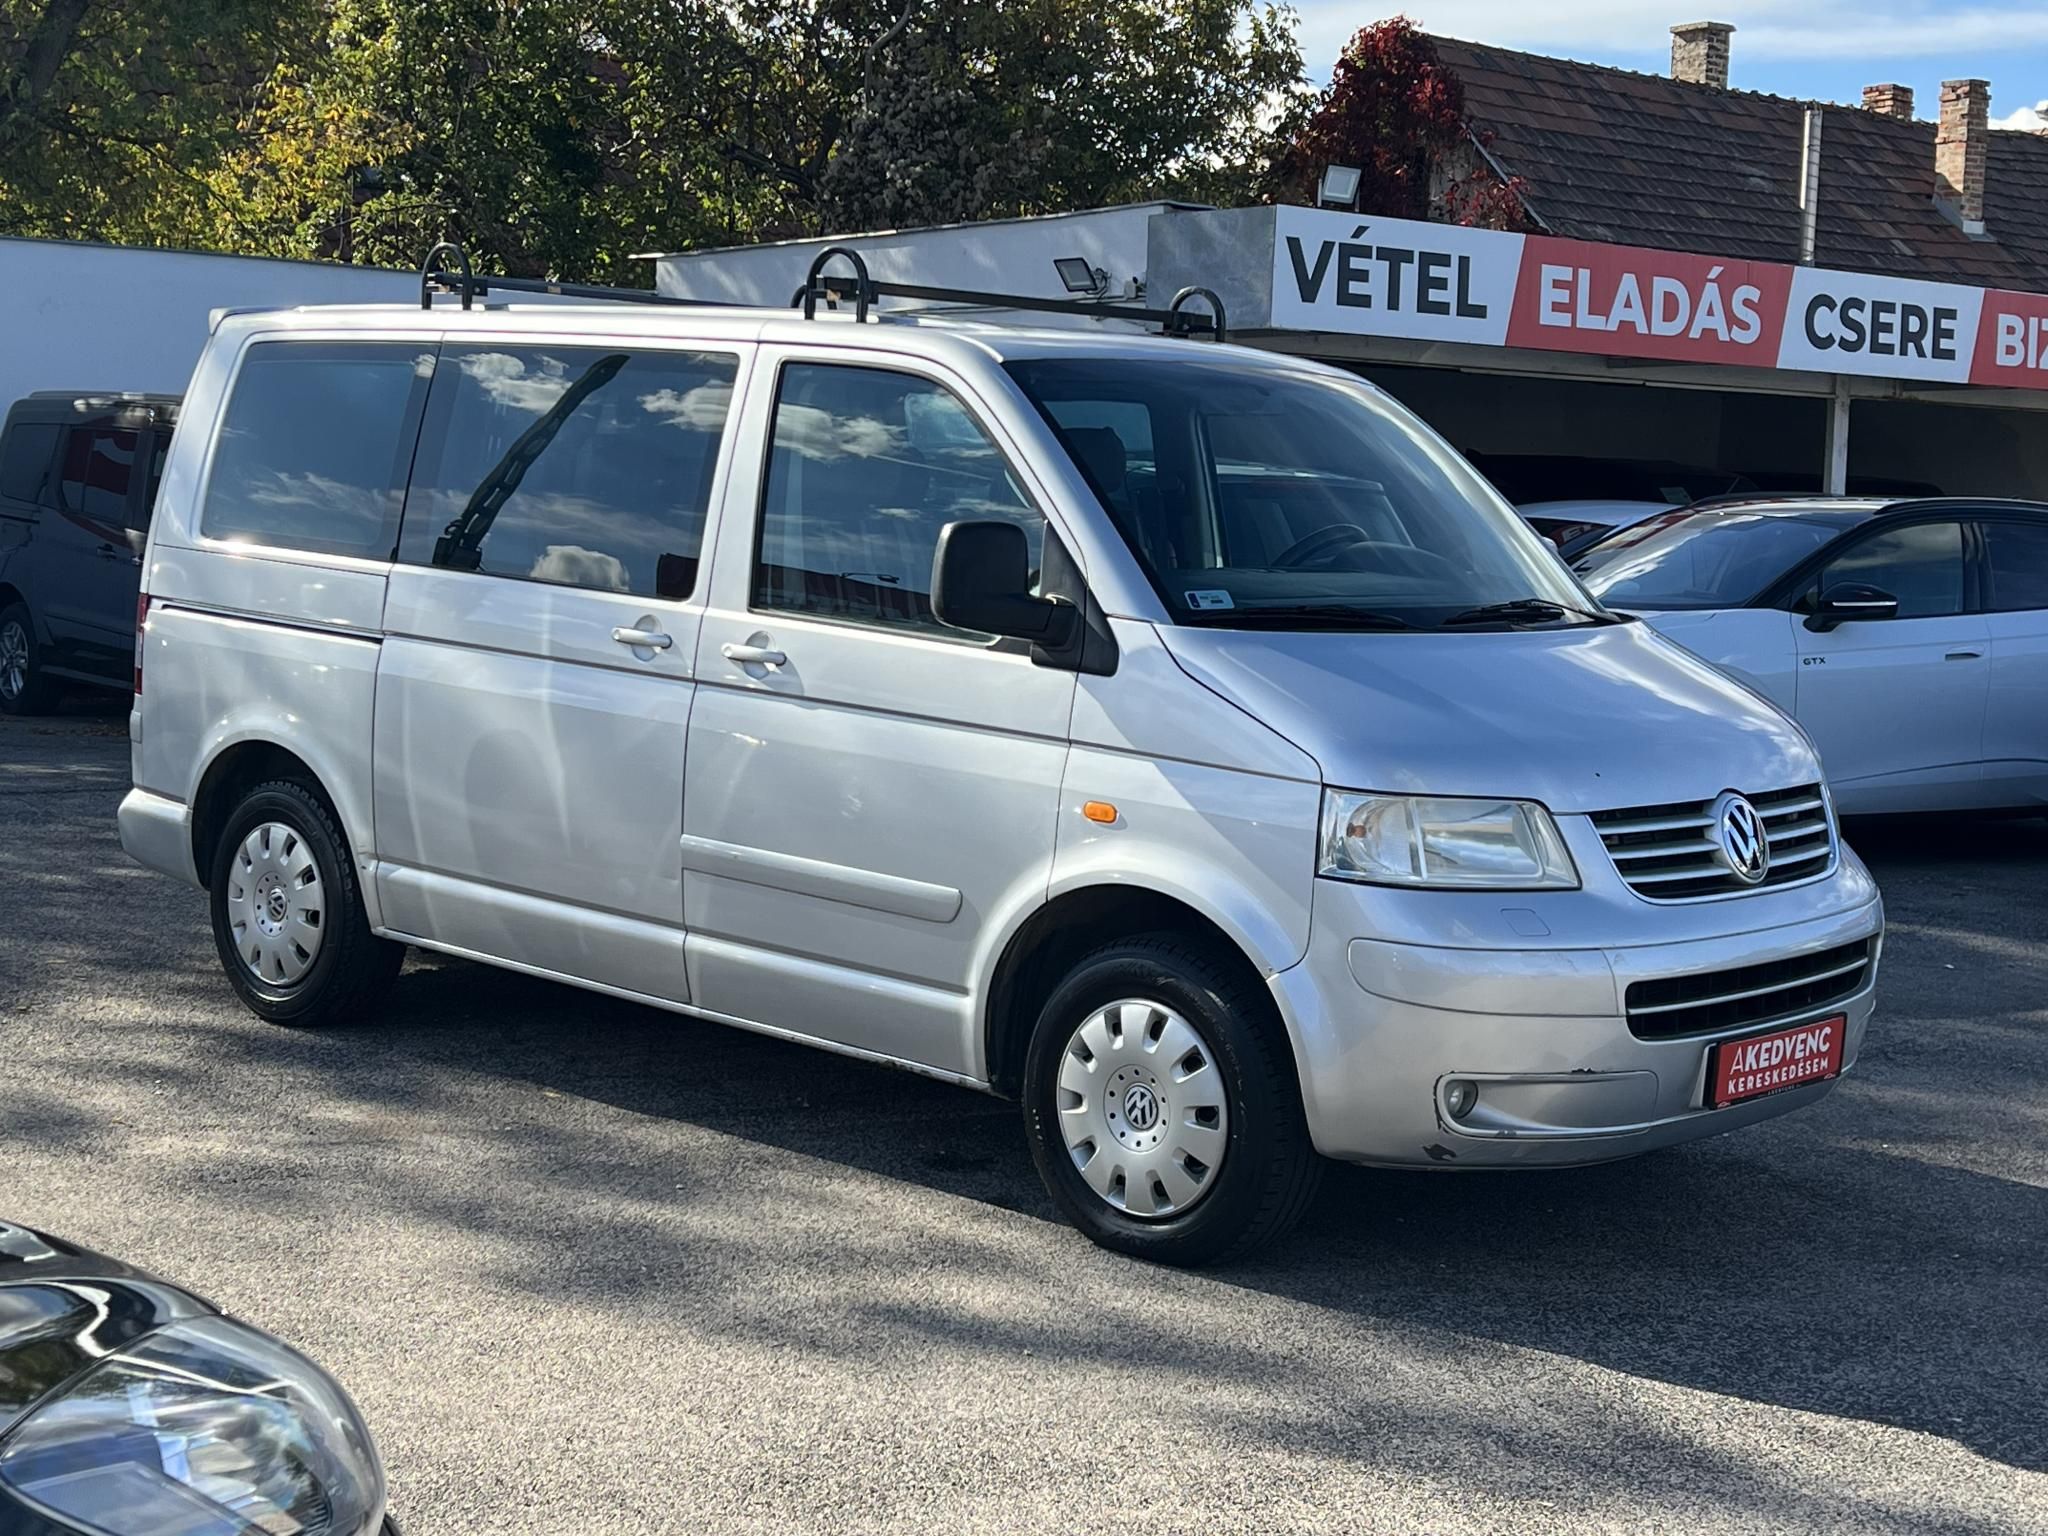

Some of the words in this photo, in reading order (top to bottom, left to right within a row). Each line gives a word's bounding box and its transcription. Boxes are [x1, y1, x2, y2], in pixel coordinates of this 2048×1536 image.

[1286, 225, 1487, 319] VÉTEL
[1539, 266, 1761, 344] ELADÁS
[1805, 294, 1957, 360] CSERE
[1803, 657, 1826, 665] GTX
[1728, 1056, 1828, 1095] KERESKEDÉSEM
